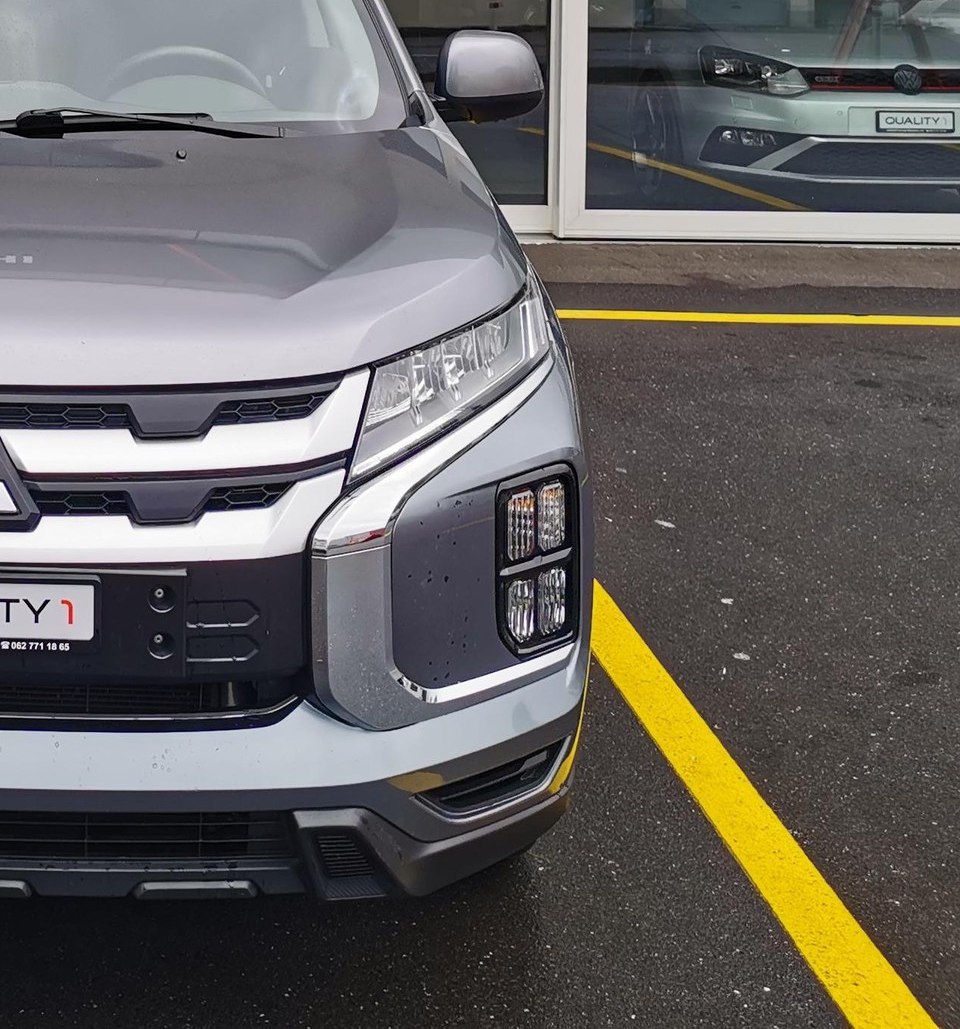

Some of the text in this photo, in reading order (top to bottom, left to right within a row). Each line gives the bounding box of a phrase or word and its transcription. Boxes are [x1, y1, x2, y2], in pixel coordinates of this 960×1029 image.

[61, 599, 74, 624] 1
[11, 641, 27, 650] 062
[29, 641, 44, 650] 771
[47, 641, 57, 650] 18
[59, 641, 70, 651] 65
